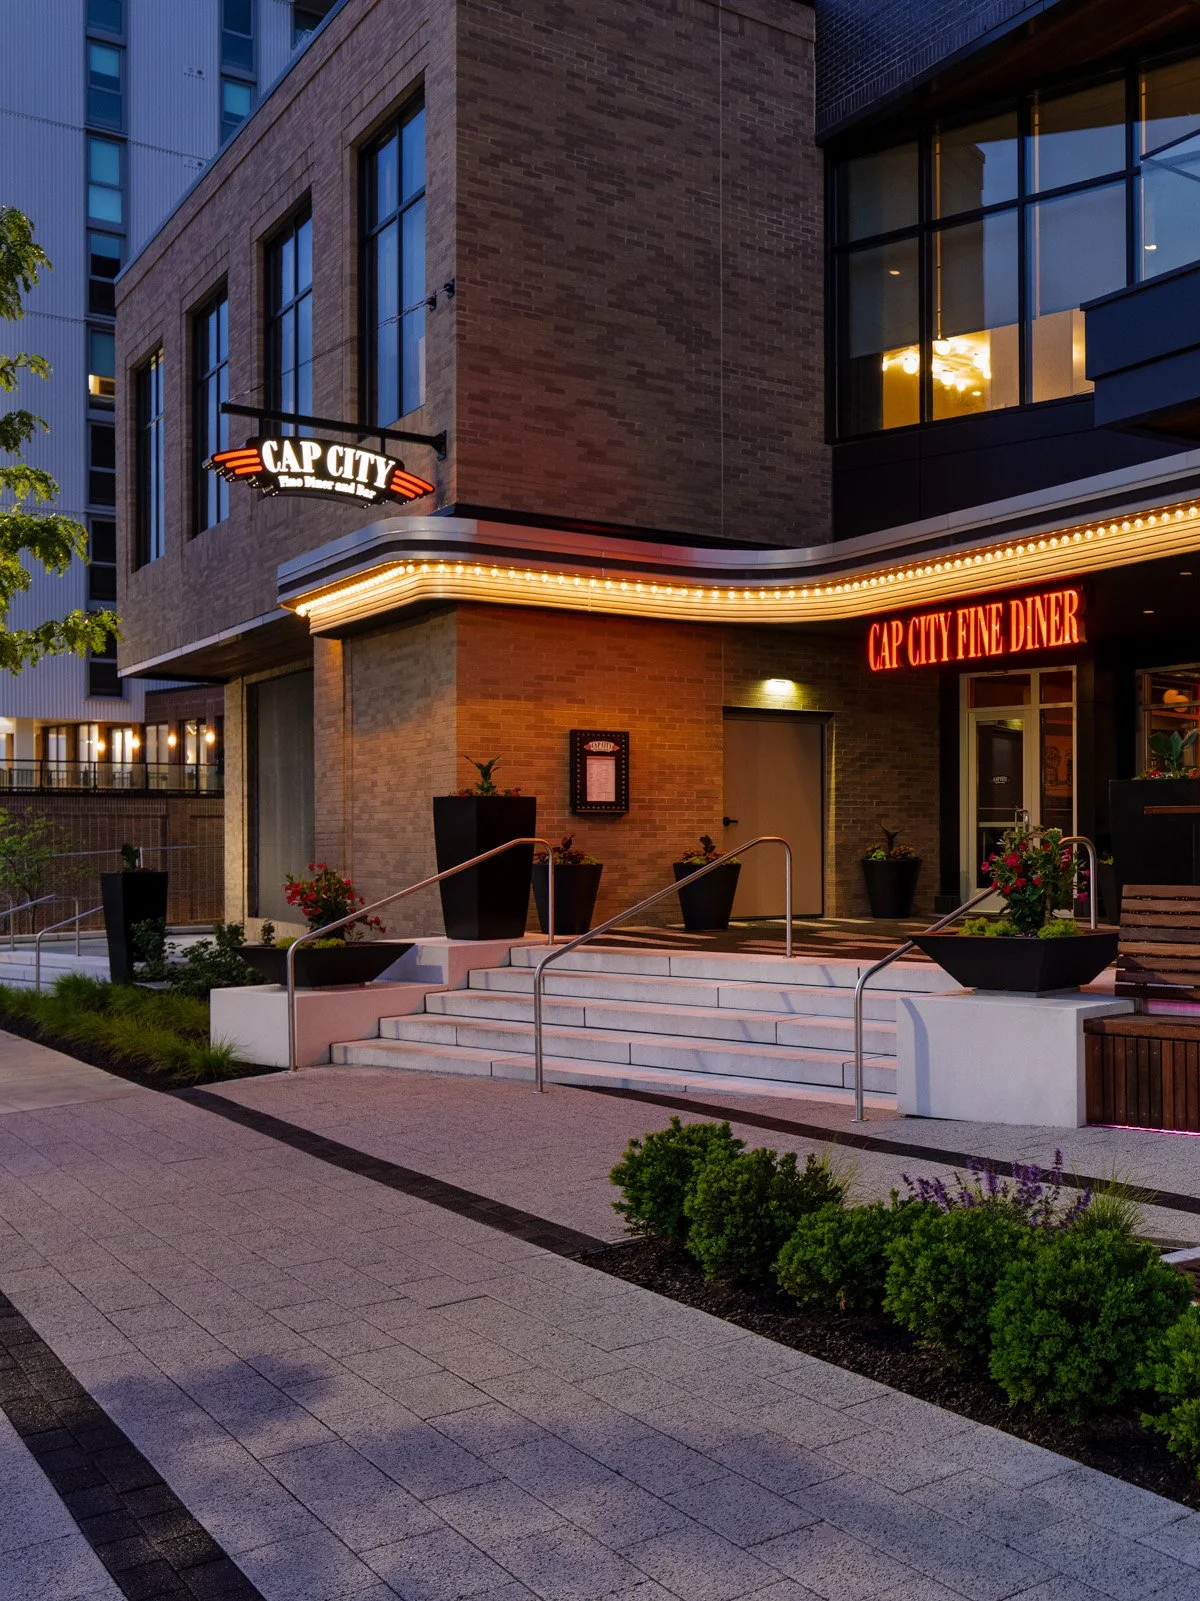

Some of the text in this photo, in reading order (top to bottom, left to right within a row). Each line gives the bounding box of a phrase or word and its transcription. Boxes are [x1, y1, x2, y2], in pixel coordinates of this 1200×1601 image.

[262, 440, 396, 488] CAP CITY
[278, 475, 303, 488] Fine
[303, 475, 335, 490] Diner
[335, 482, 356, 494] and
[869, 589, 1079, 671] CAP CITY FINE DINER
